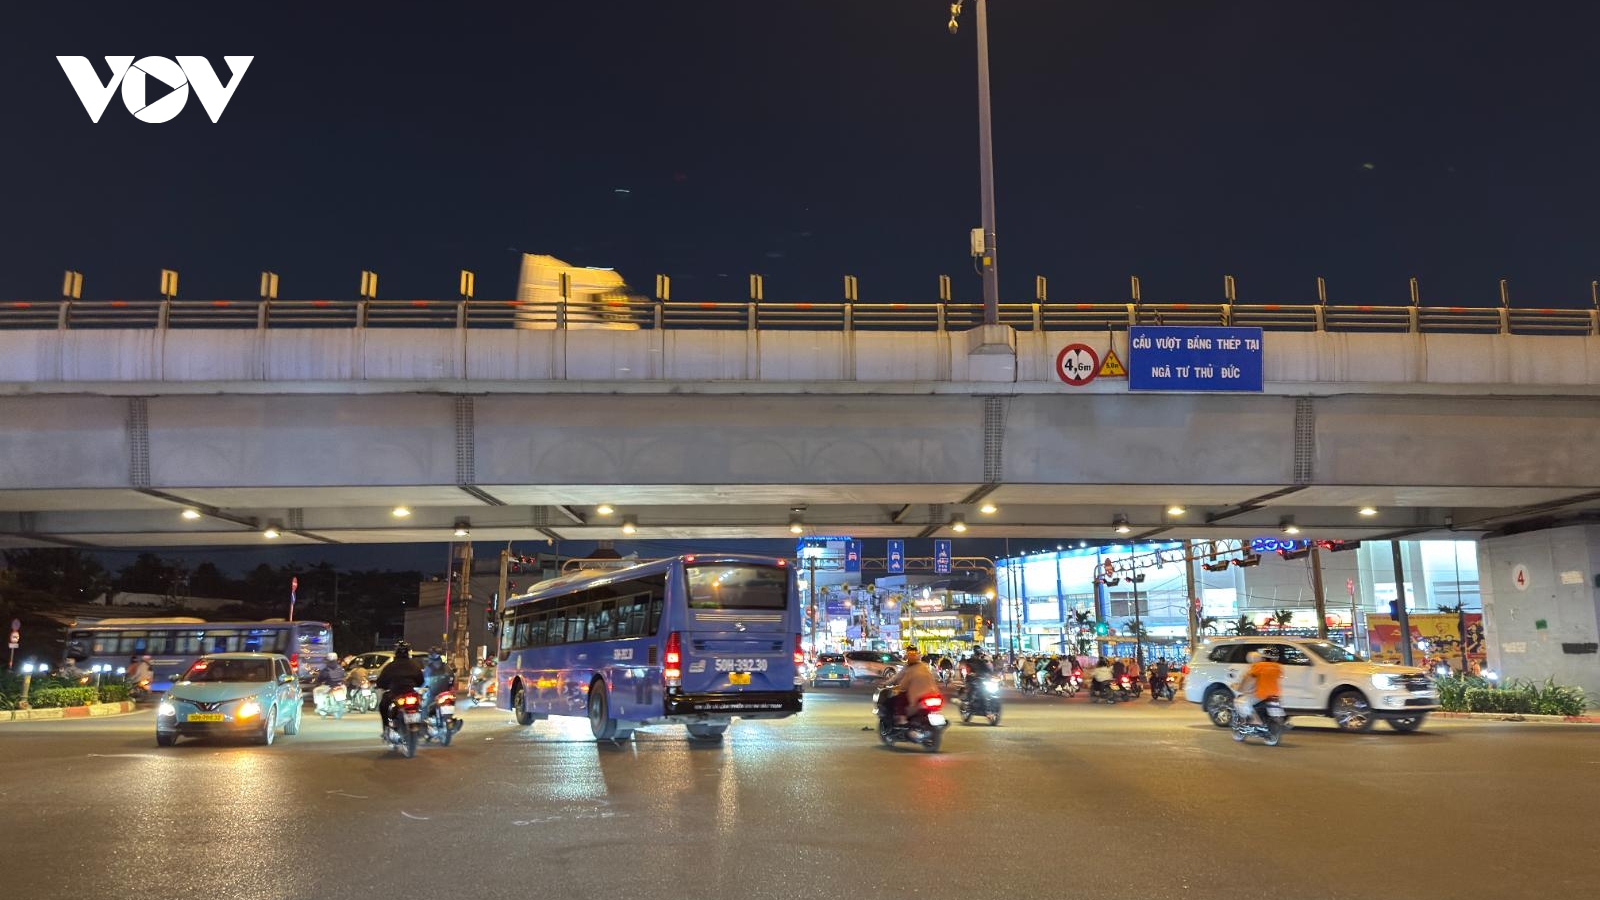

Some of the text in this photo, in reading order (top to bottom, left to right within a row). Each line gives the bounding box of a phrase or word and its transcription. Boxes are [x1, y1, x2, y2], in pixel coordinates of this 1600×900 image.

[1132, 334, 1151, 349] CẦU
[1156, 336, 1182, 352] VƯỢT
[1217, 337, 1242, 350] THÉP
[1245, 338, 1260, 352] TẠI
[1065, 358, 1091, 374] 4,6m
[1151, 363, 1240, 379] NGÃ TƯ THỦ ĐỨC
[1517, 569, 1525, 585] 4
[715, 658, 767, 672] 50H-392.30
